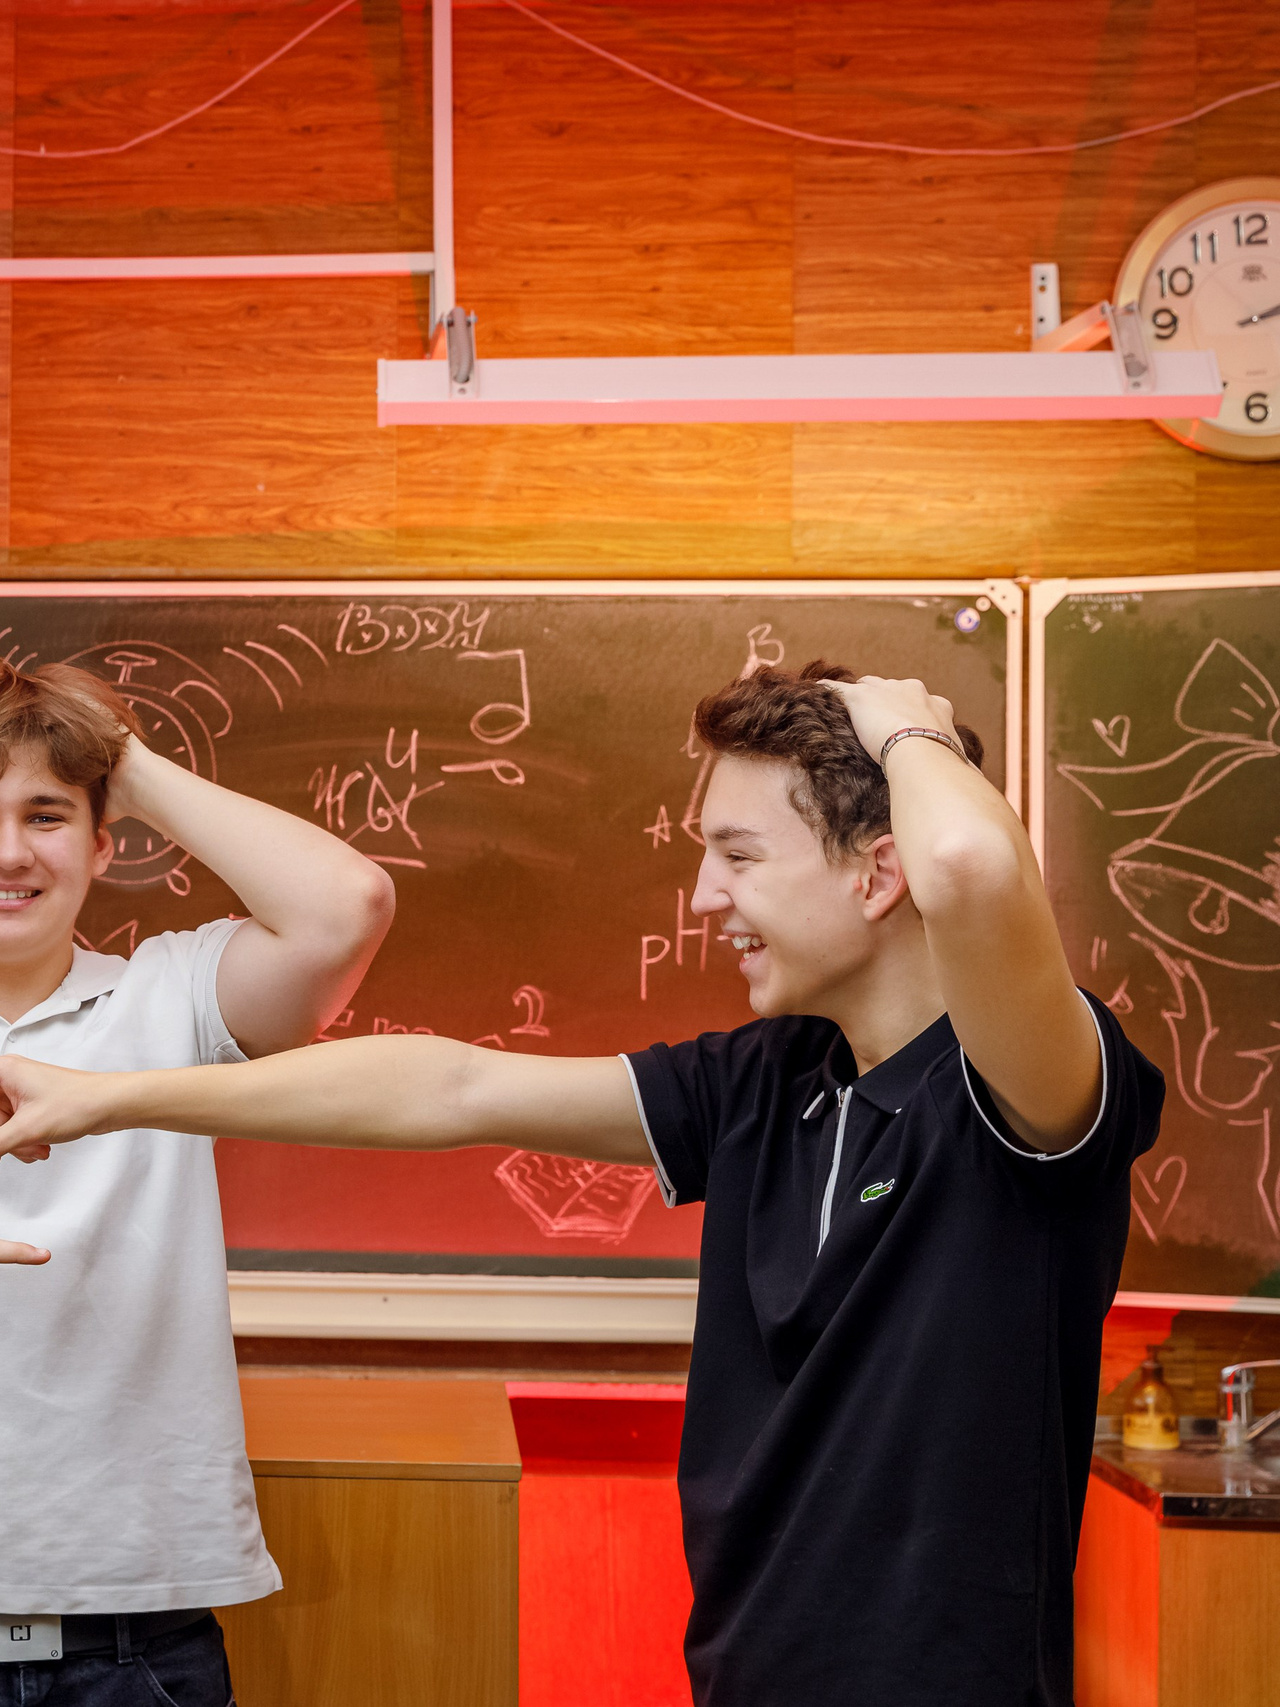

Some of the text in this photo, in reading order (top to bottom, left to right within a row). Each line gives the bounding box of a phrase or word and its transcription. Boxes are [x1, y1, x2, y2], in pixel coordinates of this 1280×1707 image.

[1232, 213, 1268, 247] 12
[1191, 231, 1219, 264] 11
[1157, 266, 1194, 298] 10
[1151, 308, 1179, 340] 9
[1244, 392, 1270, 423] 6
